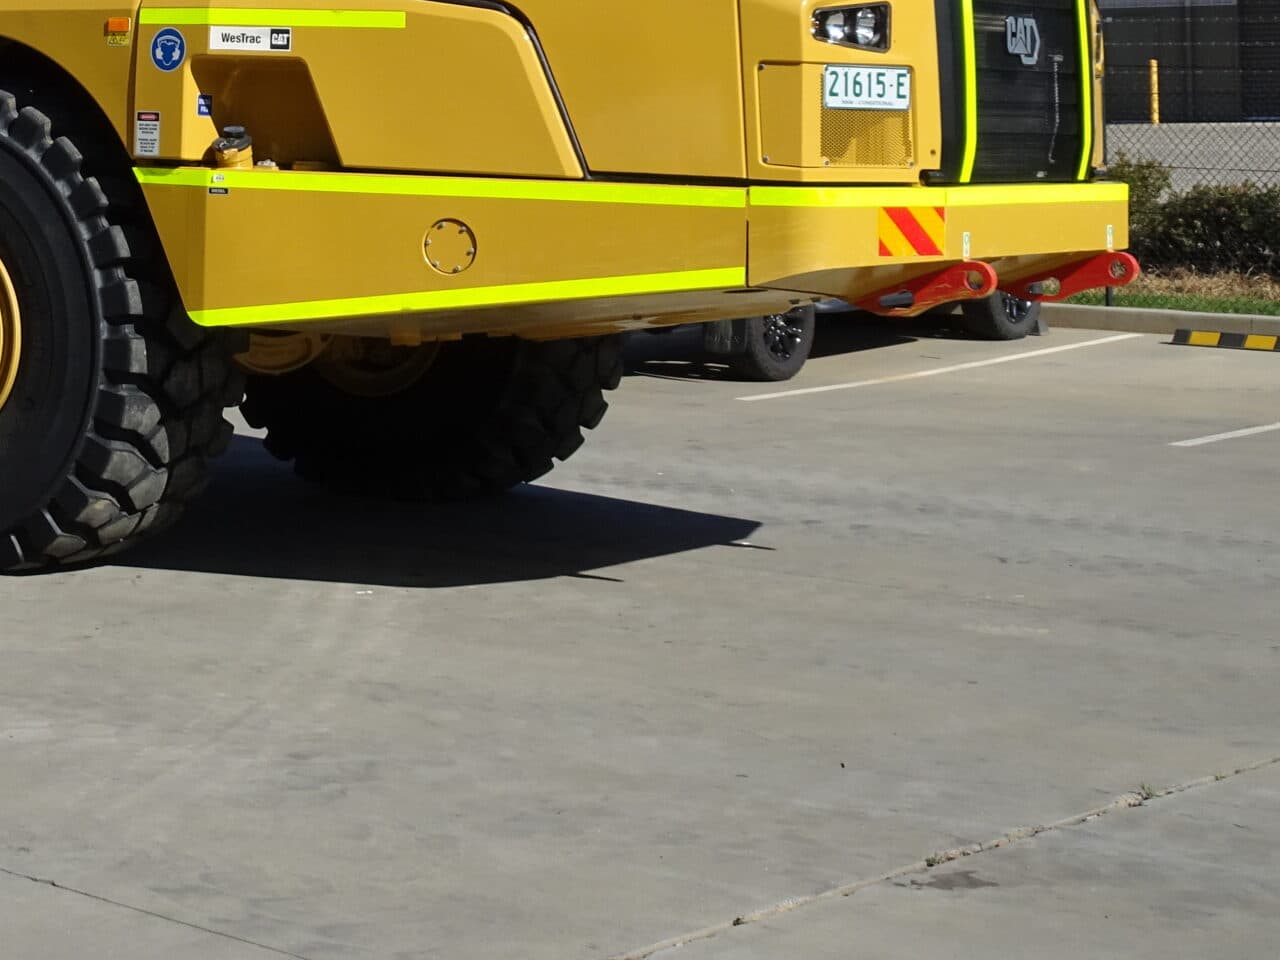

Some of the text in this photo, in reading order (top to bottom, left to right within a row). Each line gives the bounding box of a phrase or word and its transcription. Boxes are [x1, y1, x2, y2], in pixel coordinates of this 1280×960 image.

[221, 32, 290, 45] WesTrac CAT
[1006, 15, 1035, 54] CAT
